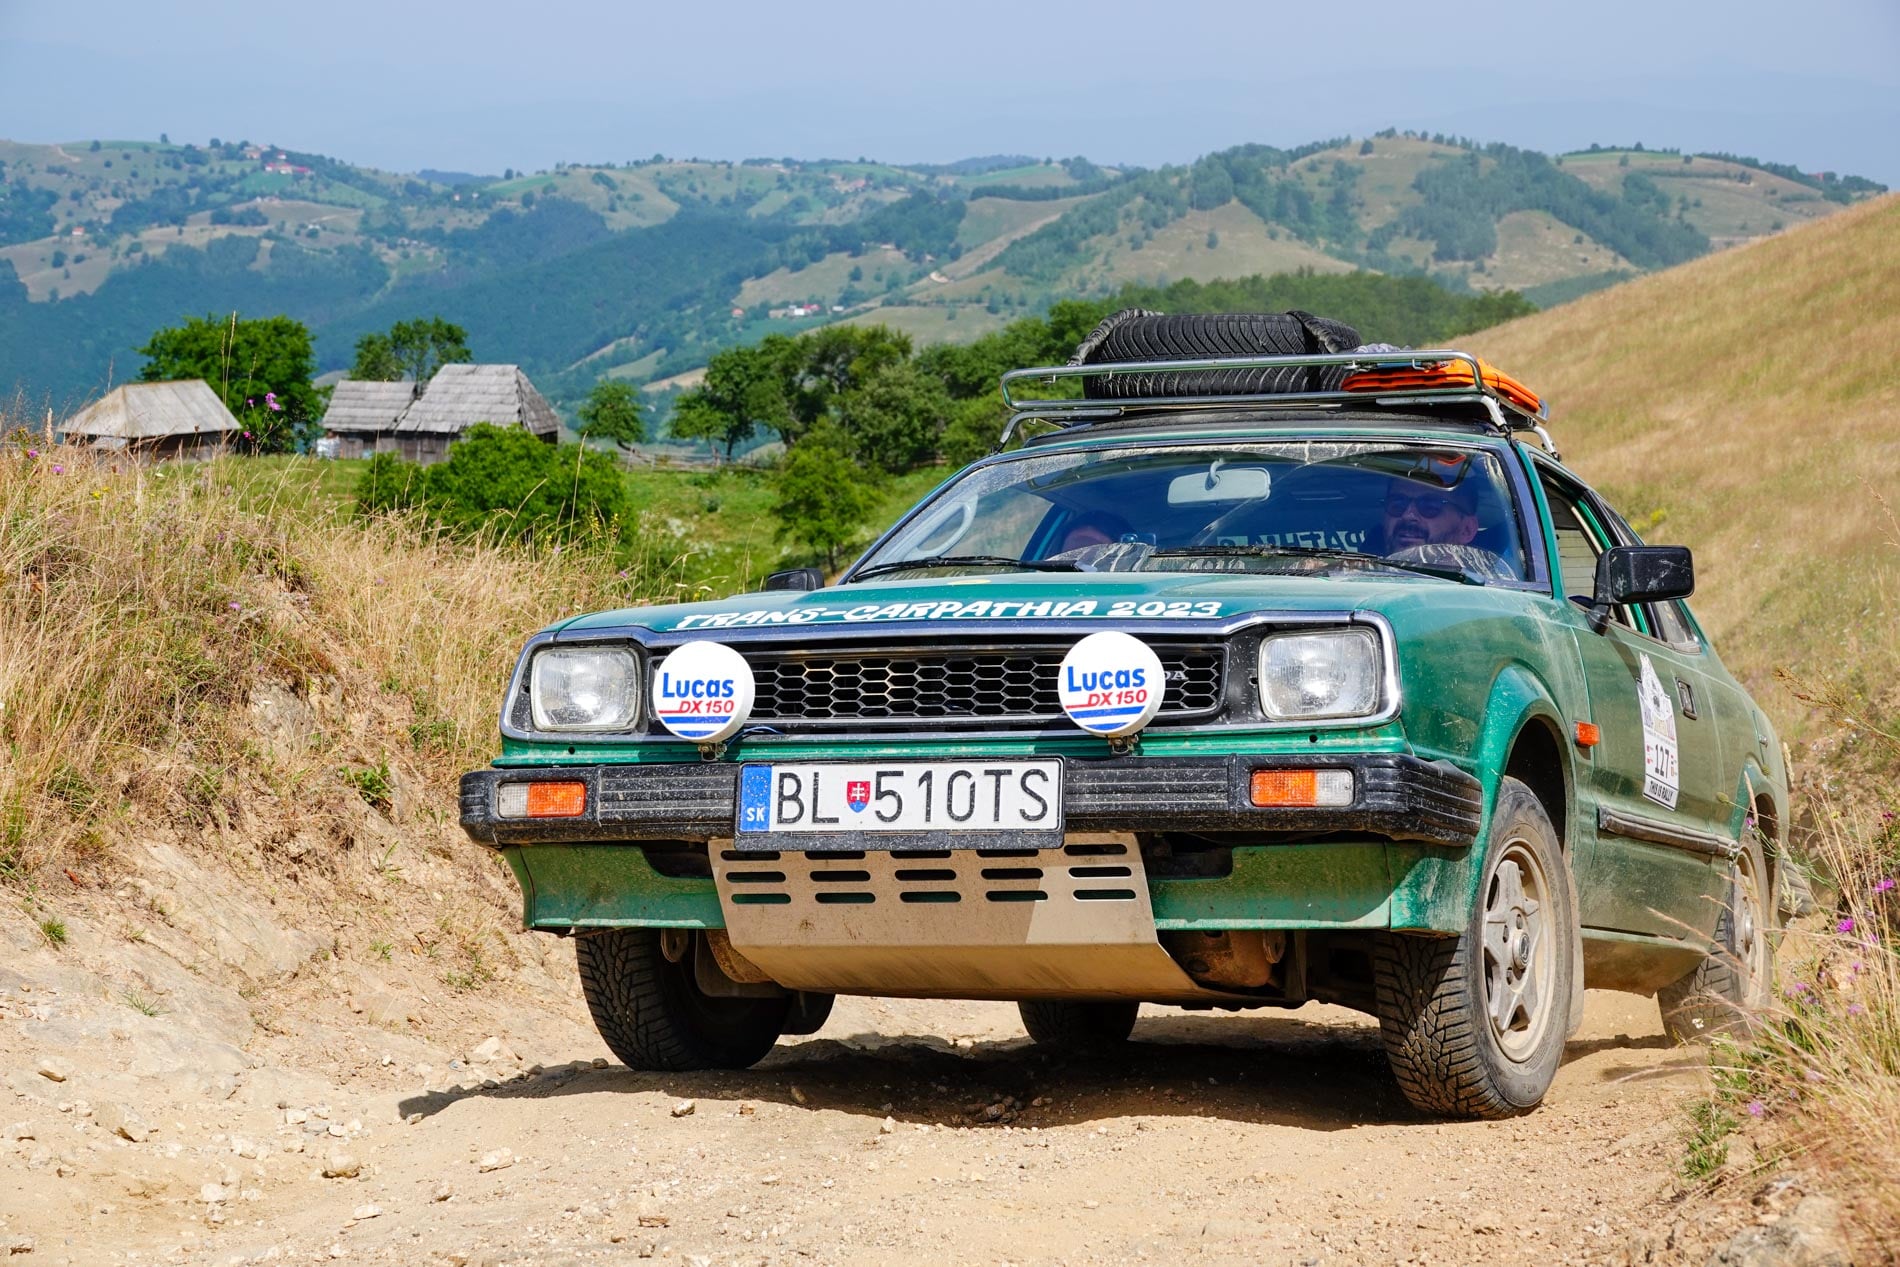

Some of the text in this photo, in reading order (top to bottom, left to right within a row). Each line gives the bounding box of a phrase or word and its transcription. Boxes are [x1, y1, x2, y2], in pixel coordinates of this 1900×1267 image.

[677, 600, 1222, 629] TRANS-CARPATHIA 2023
[662, 672, 734, 698] Lucas
[1067, 666, 1146, 692] Lucas
[679, 700, 734, 713] DX 150
[1087, 689, 1147, 706] DX 150
[1654, 744, 1670, 779] 127
[777, 768, 1049, 824] BL 510TS
[746, 806, 765, 822] SK
